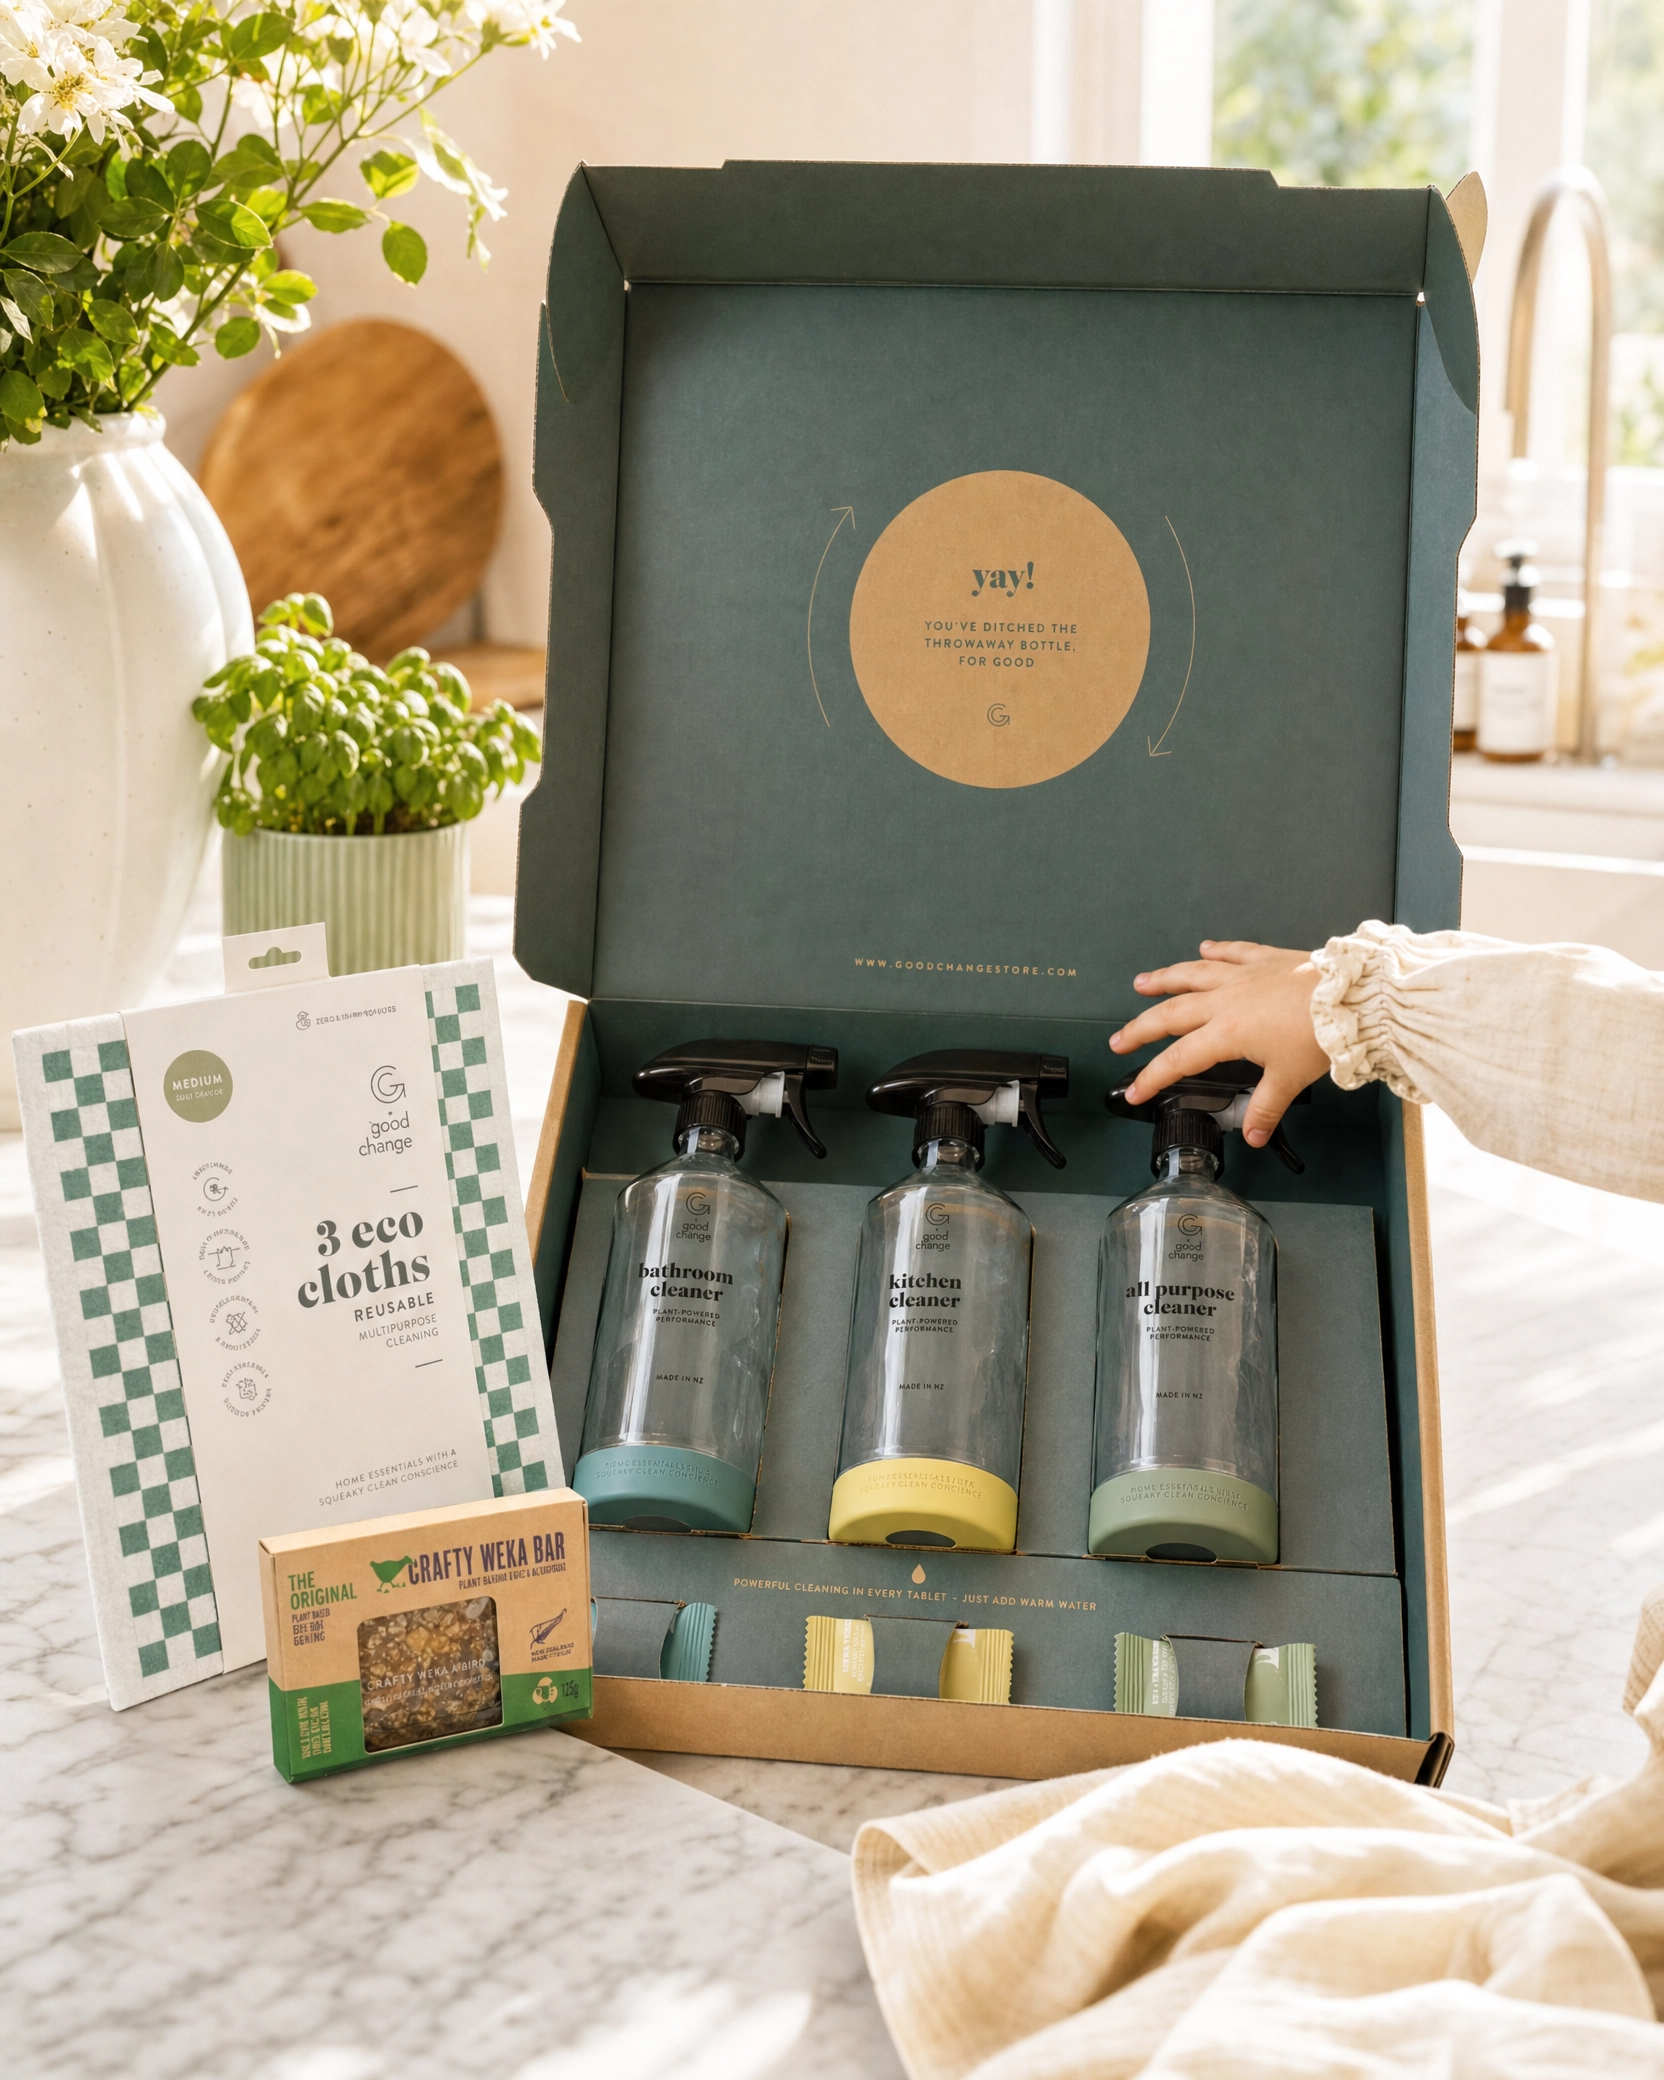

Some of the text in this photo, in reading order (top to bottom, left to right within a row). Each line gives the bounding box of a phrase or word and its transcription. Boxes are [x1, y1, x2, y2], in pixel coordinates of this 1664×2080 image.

[971, 561, 1035, 598] yay!
[924, 621, 1077, 634] YOU'VE DITCHED THE
[924, 638, 1076, 653] THROWAWAY BOTTLE,
[959, 656, 1035, 668] FOR GOOD
[854, 957, 1077, 977] WWW.GOODCHANGESTORE.COM
[172, 1073, 223, 1091] MEDIUM
[370, 1110, 410, 1139] good
[358, 1136, 413, 1157] change
[316, 1211, 424, 1257] 3 eco
[676, 1230, 711, 1243] change
[682, 1221, 709, 1233] good
[922, 1230, 949, 1243] good
[915, 1241, 951, 1252] change
[1168, 1250, 1204, 1262] change
[1175, 1241, 1202, 1253] good
[297, 1249, 431, 1309] cloths
[638, 1262, 734, 1285] bathroom
[889, 1272, 962, 1290] kitchen
[650, 1281, 724, 1302] cleaner
[888, 1291, 961, 1309] cleaner
[1125, 1280, 1235, 1301] all purpose
[354, 1291, 435, 1322] REUSABLE
[1143, 1299, 1217, 1317] cleaner
[359, 1313, 437, 1341] MULTIPURPOSE
[385, 1327, 439, 1348] CLEANING
[934, 1383, 945, 1391] NZ
[1156, 1391, 1179, 1399] MADE
[1193, 1392, 1203, 1400] NZ
[335, 1448, 457, 1489] HOME ESSENTIALS WITH A
[319, 1460, 459, 1506] SQUEAKY CLEAN CONSCIENCE
[1163, 1491, 1194, 1499] CLEAN
[408, 1545, 473, 1585] CRAFTY
[479, 1538, 529, 1573] WEKA
[532, 1531, 566, 1564] BAR
[287, 1571, 316, 1592] THE
[290, 1582, 358, 1611] ORIGINAL
[734, 1578, 791, 1591] POWERFUL
[794, 1583, 849, 1595] CLEANING
[852, 1587, 864, 1596] IN
[867, 1588, 903, 1599] EVERY
[907, 1590, 947, 1602] TABLET
[962, 1594, 989, 1604] JUST
[992, 1596, 1017, 1606] ADD
[1020, 1598, 1054, 1608] WARM
[1058, 1600, 1097, 1611] WATER
[367, 1673, 415, 1691] CRAFTY
[417, 1665, 449, 1680] WEKA
